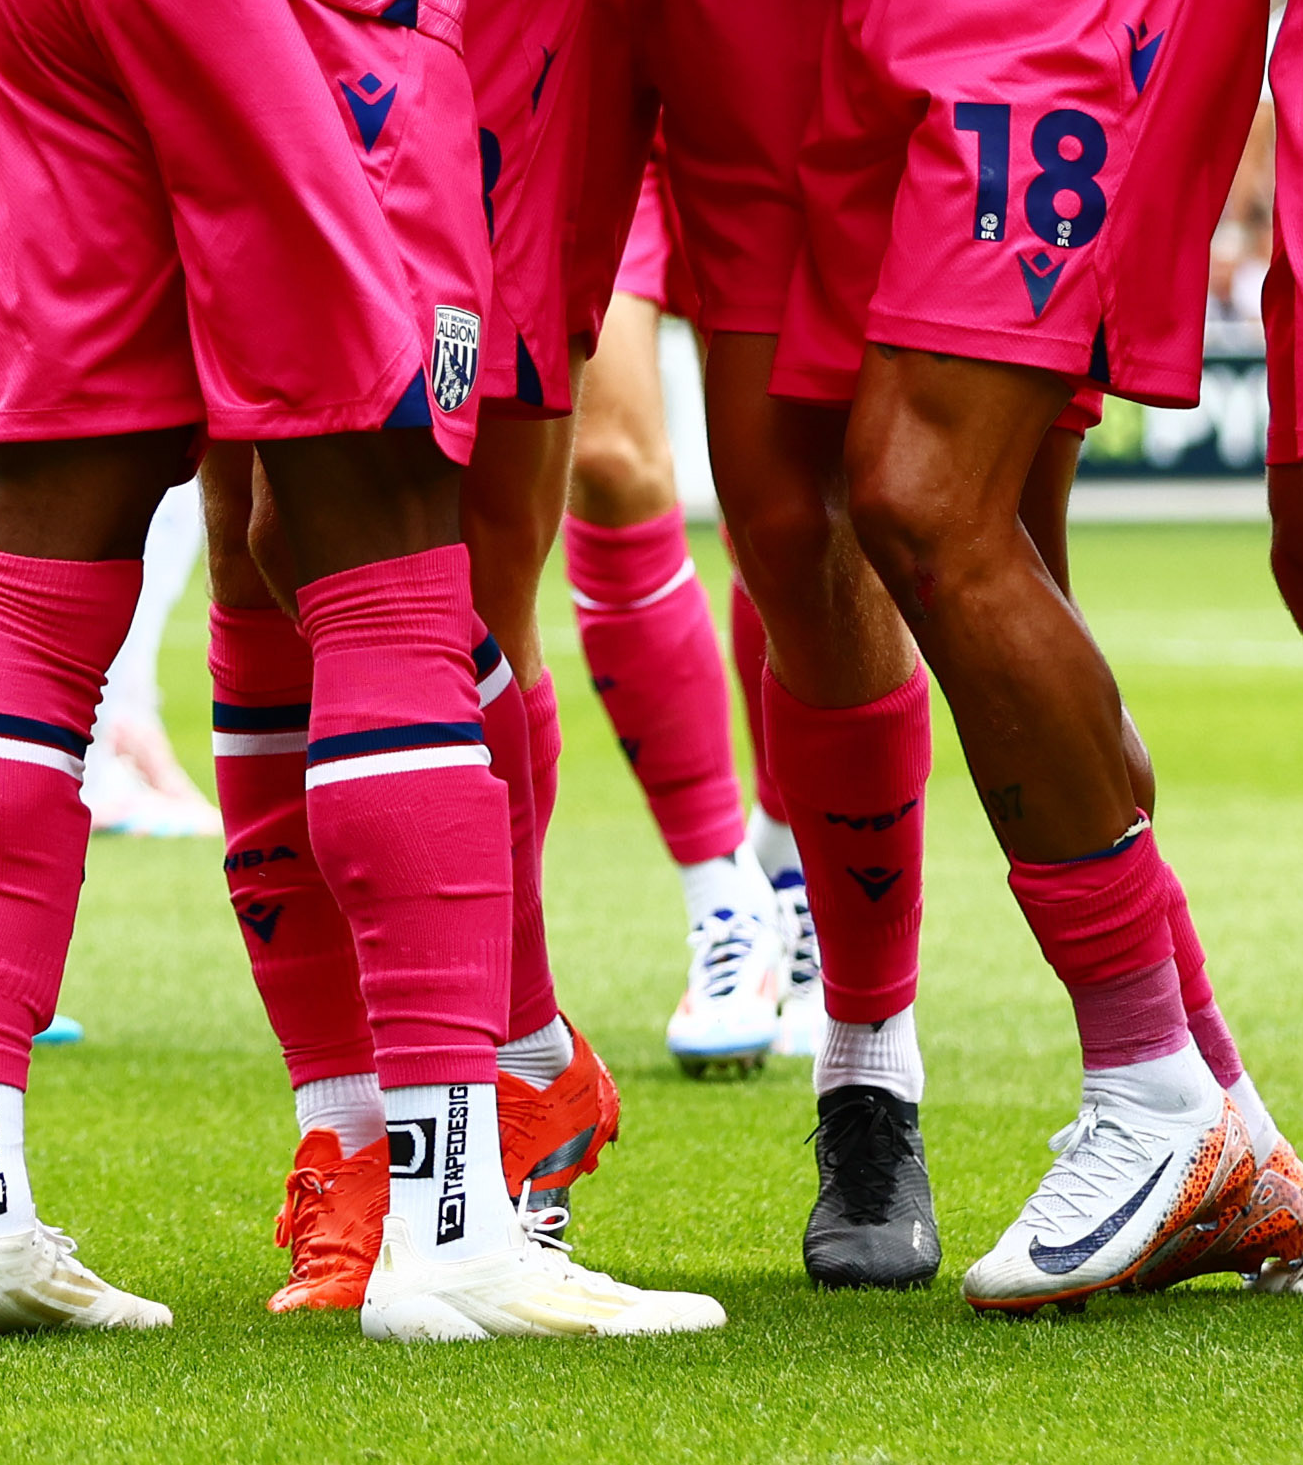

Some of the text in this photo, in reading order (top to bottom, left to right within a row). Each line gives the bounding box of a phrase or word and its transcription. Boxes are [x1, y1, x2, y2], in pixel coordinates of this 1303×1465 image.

[954, 102, 1108, 249] 18
[980, 230, 997, 241] EFL
[1056, 237, 1070, 247] EFL
[438, 320, 476, 344] ALBION
[442, 1083, 469, 1196] TAPEDESIG
